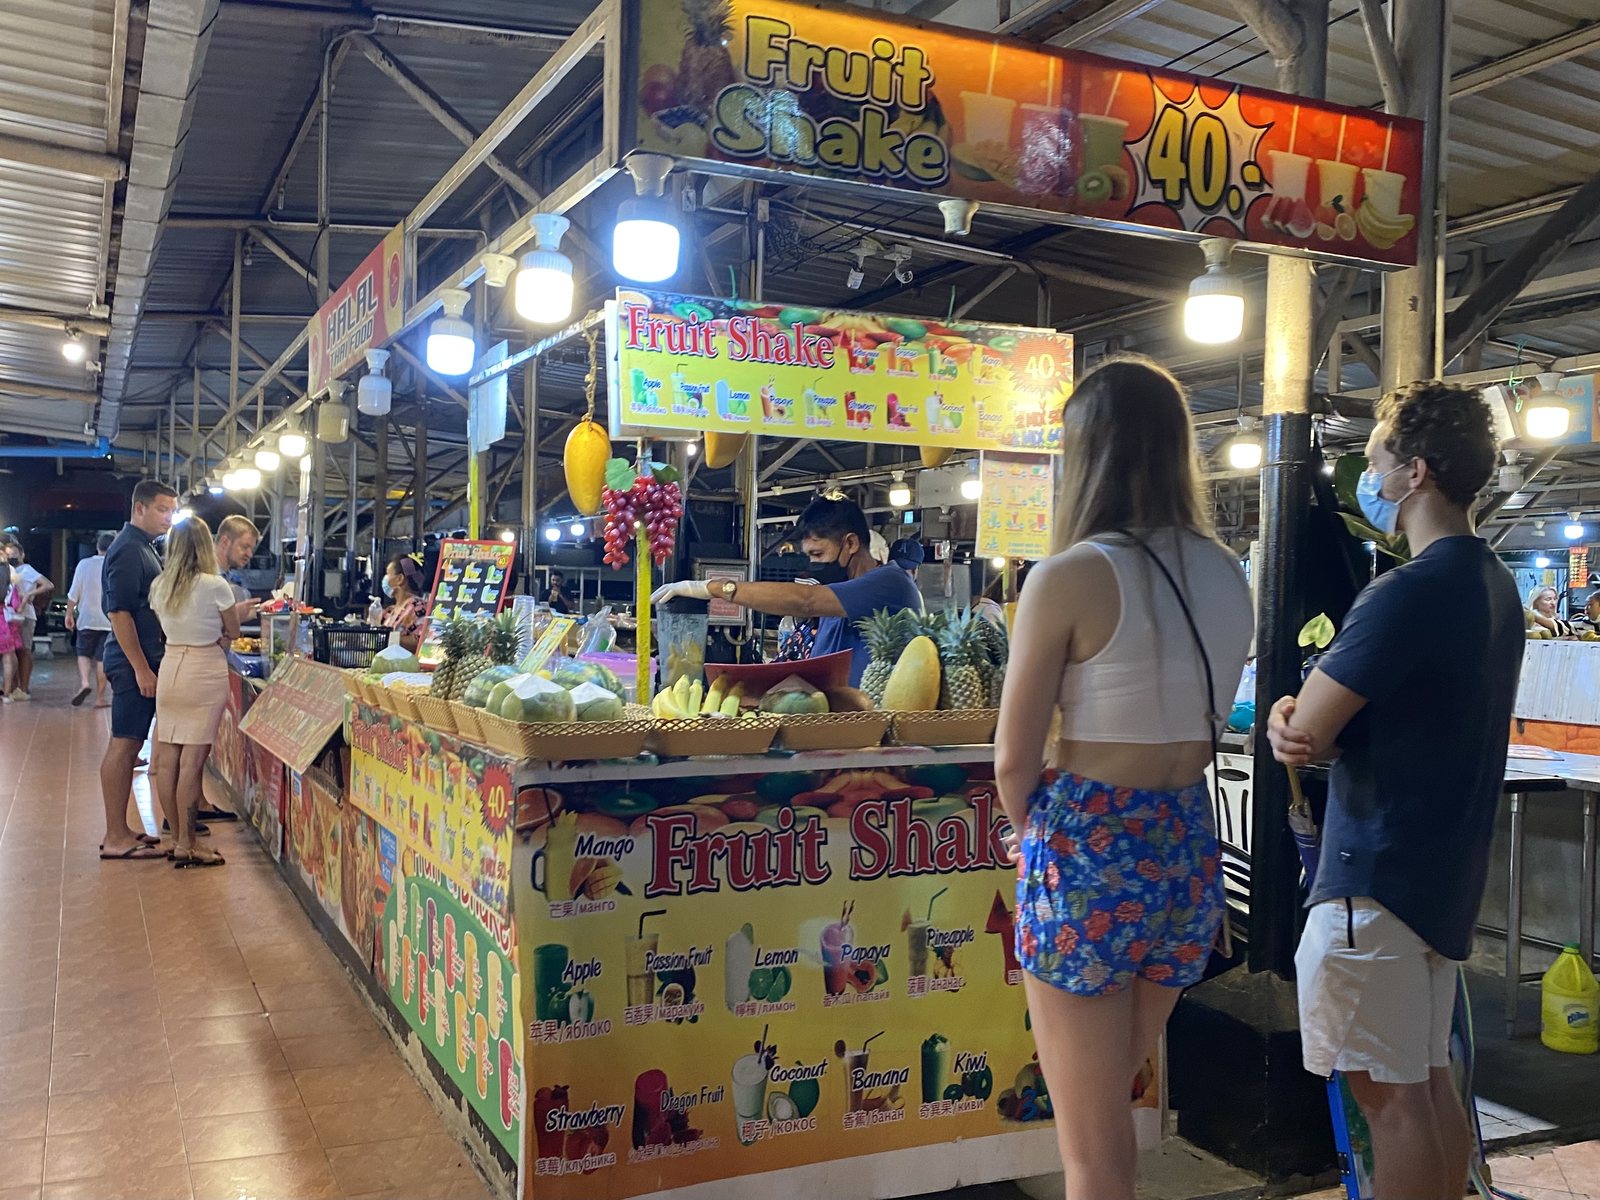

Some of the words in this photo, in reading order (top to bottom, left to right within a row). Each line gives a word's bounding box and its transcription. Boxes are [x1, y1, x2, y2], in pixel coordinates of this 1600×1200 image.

[744, 15, 934, 108] Fruit
[711, 84, 948, 186] Shake
[327, 270, 378, 351] HALAL
[349, 317, 375, 353] FOOD
[625, 302, 718, 359] Fruit
[727, 315, 836, 369] Shake
[643, 376, 662, 390] Apple
[729, 389, 751, 400] Lemon
[574, 834, 635, 861] Mango
[644, 805, 833, 899] Fruit
[849, 791, 1018, 881] Shak
[926, 924, 975, 947] Pineapple
[645, 951, 686, 971] Passion
[686, 944, 713, 968] Fruit
[755, 946, 799, 967] Lemon
[841, 943, 891, 965] Papaya
[563, 957, 603, 986] Apple
[770, 1058, 828, 1082] Coconut
[953, 1051, 988, 1074] Kiwi
[852, 1067, 910, 1091] Banana
[660, 1087, 698, 1113] Dragon
[699, 1085, 725, 1105] Fruit
[546, 1102, 625, 1131] Strawberry
